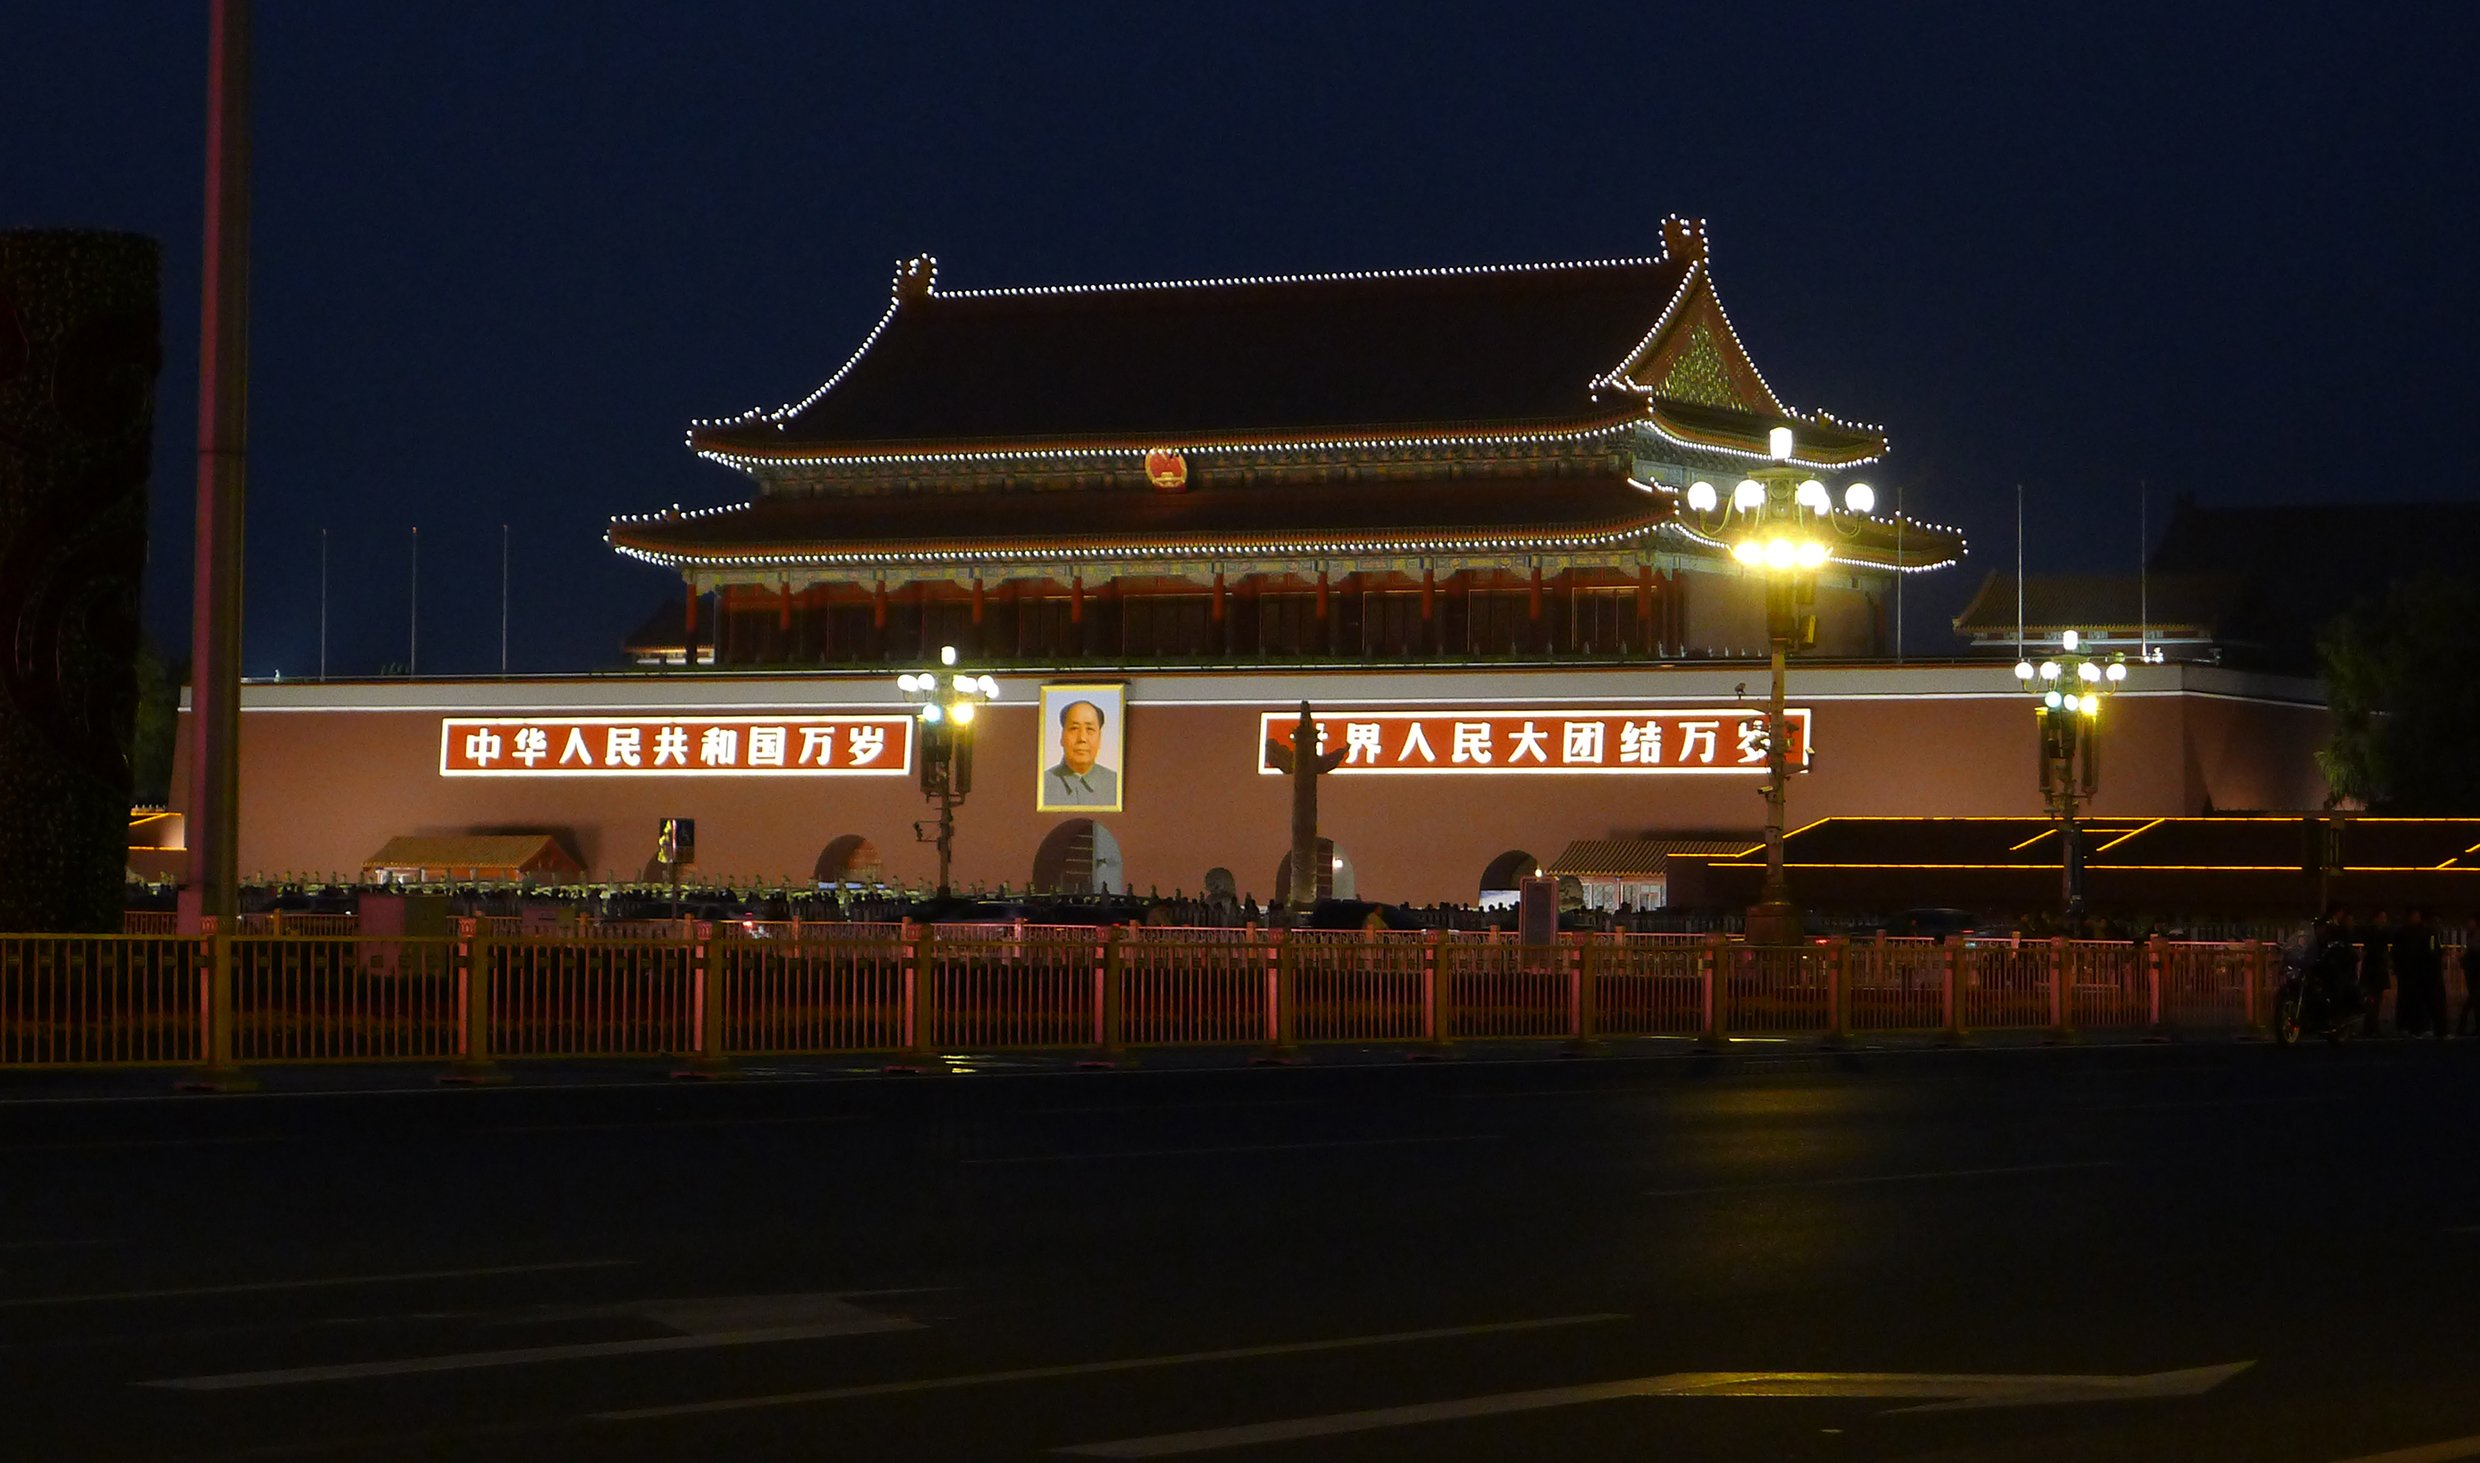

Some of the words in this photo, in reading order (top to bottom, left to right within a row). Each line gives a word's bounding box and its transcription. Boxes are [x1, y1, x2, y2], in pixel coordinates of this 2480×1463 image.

[465, 726, 886, 767] 中华人民共和国万岁
